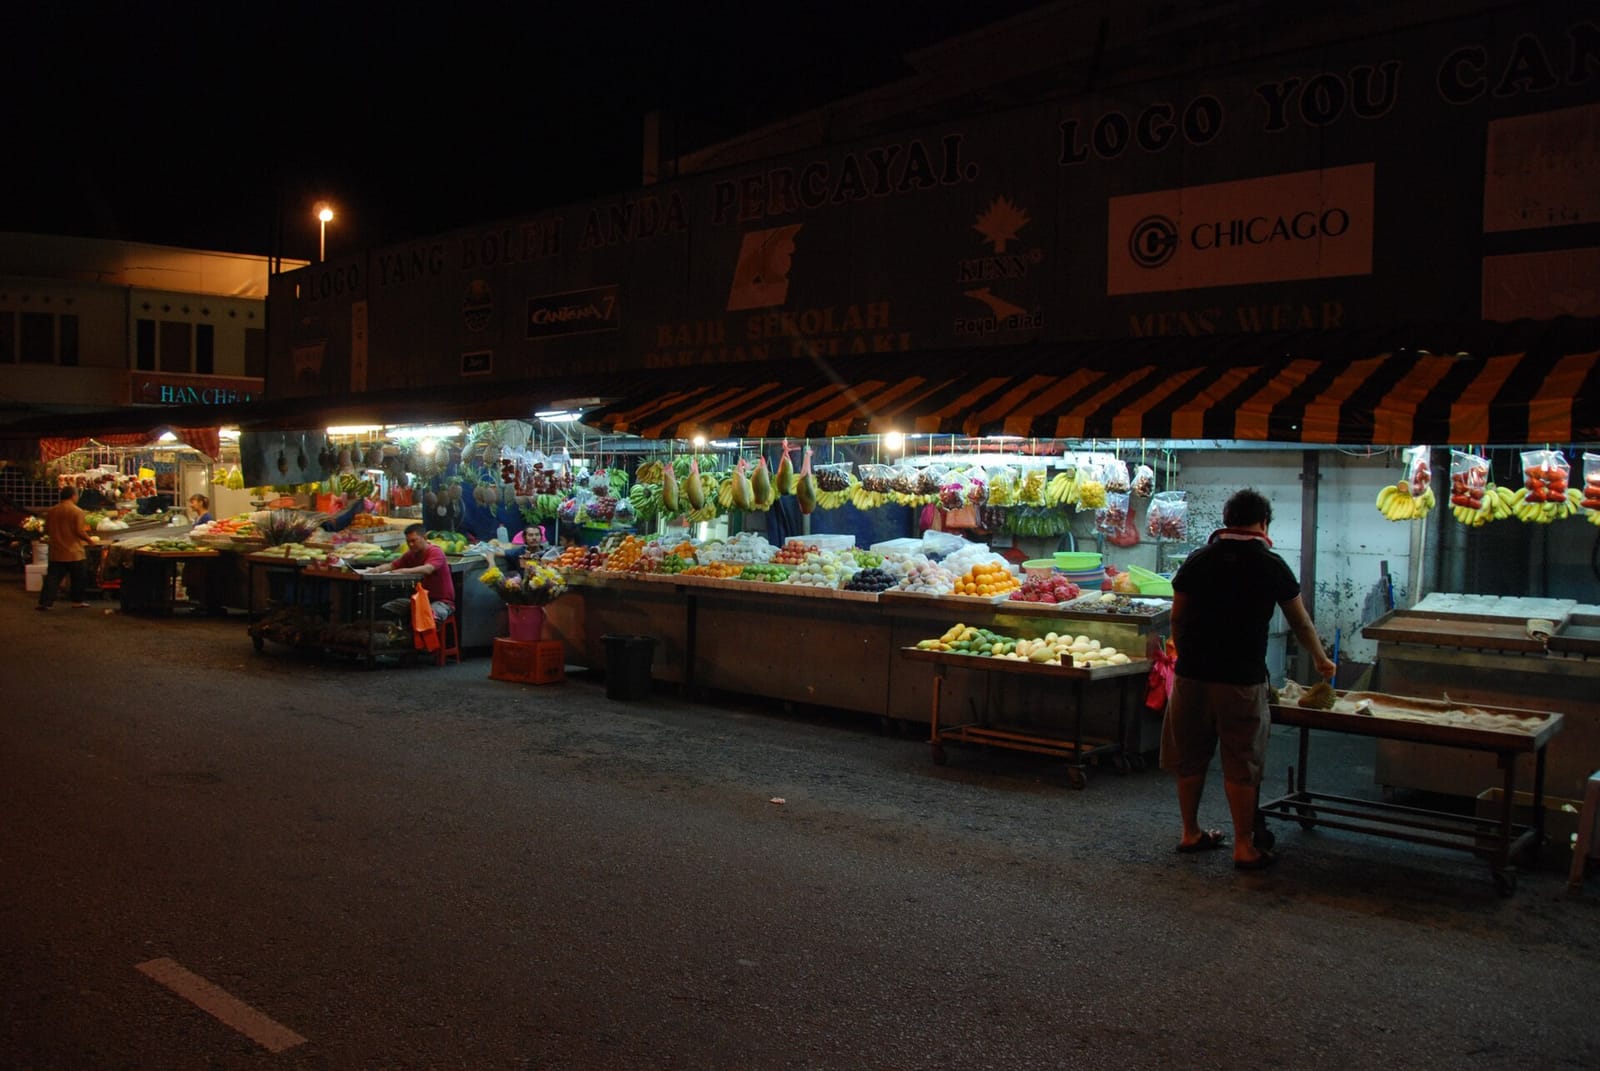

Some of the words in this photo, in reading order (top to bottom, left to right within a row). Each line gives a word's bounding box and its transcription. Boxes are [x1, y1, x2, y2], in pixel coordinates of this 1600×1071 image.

[1056, 94, 1226, 166] LOGO
[1256, 60, 1402, 133] YOU
[308, 262, 360, 301] LOGO
[376, 244, 444, 287] YANG
[460, 215, 565, 272] BOLEH
[576, 189, 689, 251] ANDA
[711, 134, 980, 226] PERCAYAI.
[1191, 208, 1349, 250] CHICAGO
[656, 319, 726, 348] BAJU
[747, 301, 892, 341] SEKOLAH
[1236, 302, 1346, 333] WEAR
